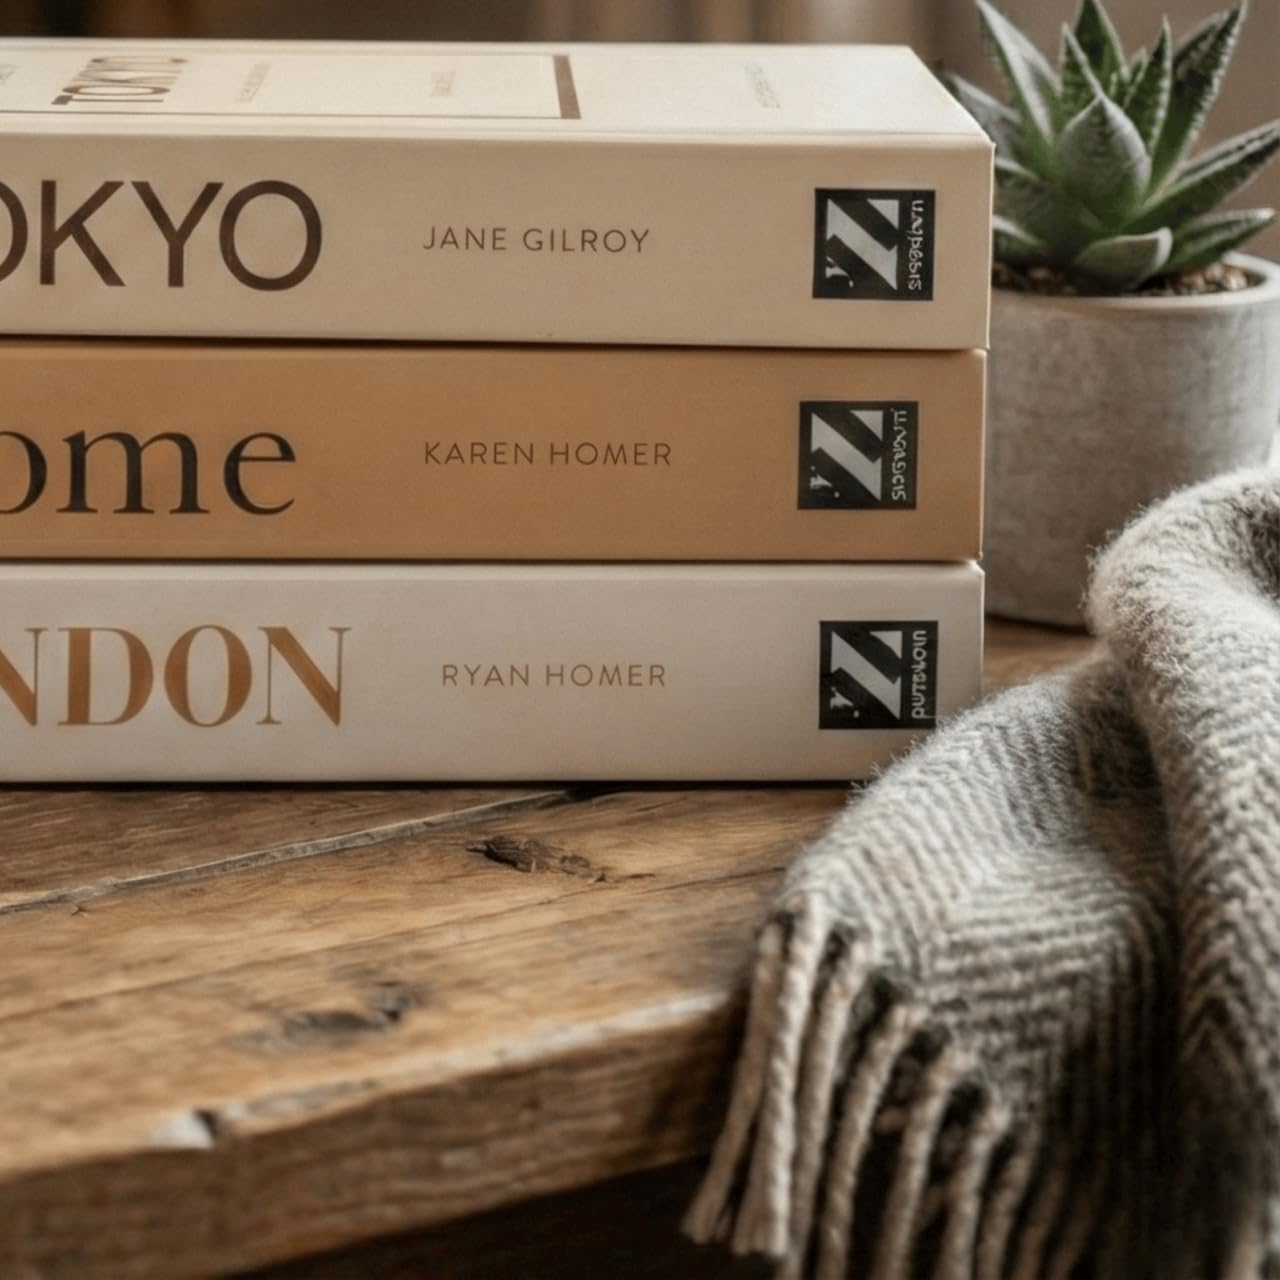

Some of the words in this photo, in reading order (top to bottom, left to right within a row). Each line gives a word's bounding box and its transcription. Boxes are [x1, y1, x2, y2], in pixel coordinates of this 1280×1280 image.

[423, 226, 507, 251] JANE
[522, 228, 650, 253] GILROY
[424, 441, 534, 465] KAREN
[549, 441, 672, 466] HOMER
[442, 664, 529, 687] RYAN
[545, 663, 666, 687] HOMER
